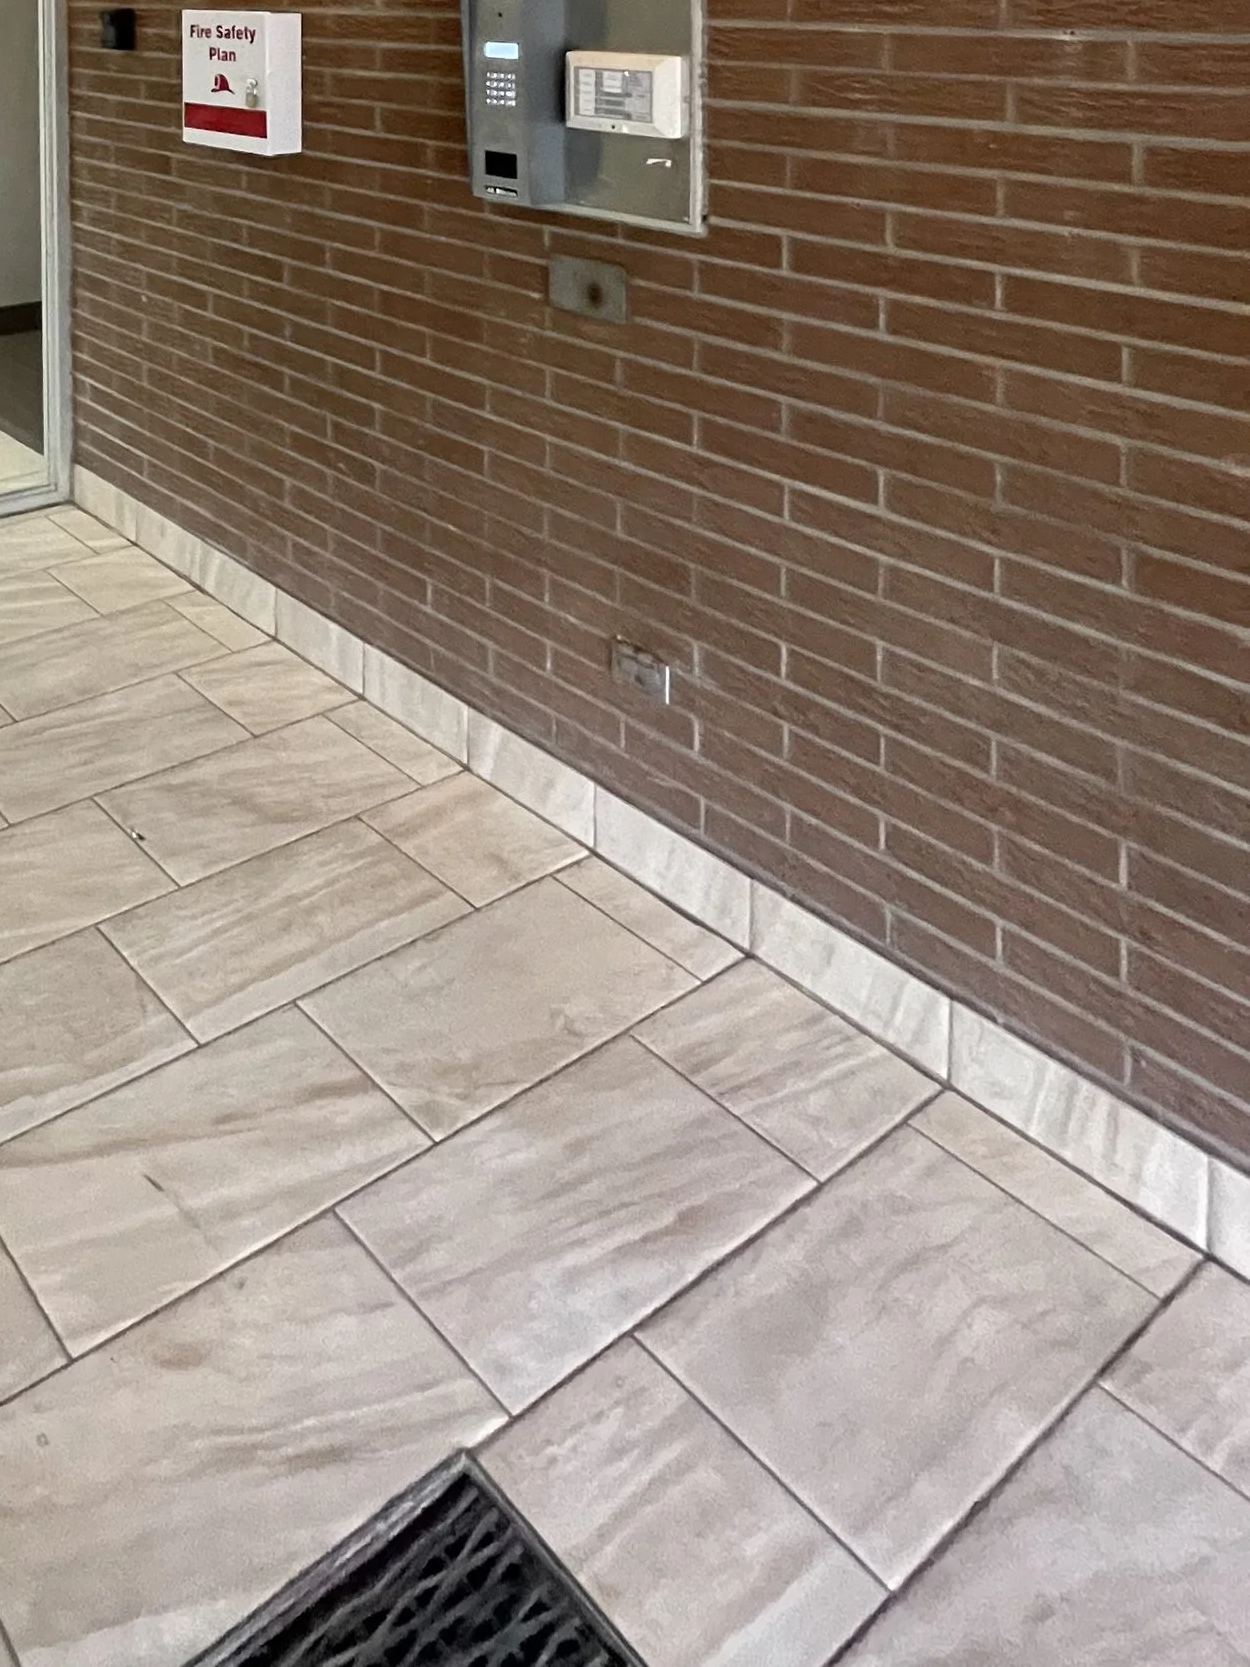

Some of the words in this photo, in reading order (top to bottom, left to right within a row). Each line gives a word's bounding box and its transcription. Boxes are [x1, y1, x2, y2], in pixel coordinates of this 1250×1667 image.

[189, 24, 211, 39] Fire
[216, 24, 256, 44] Safety
[209, 46, 236, 62] Plan
